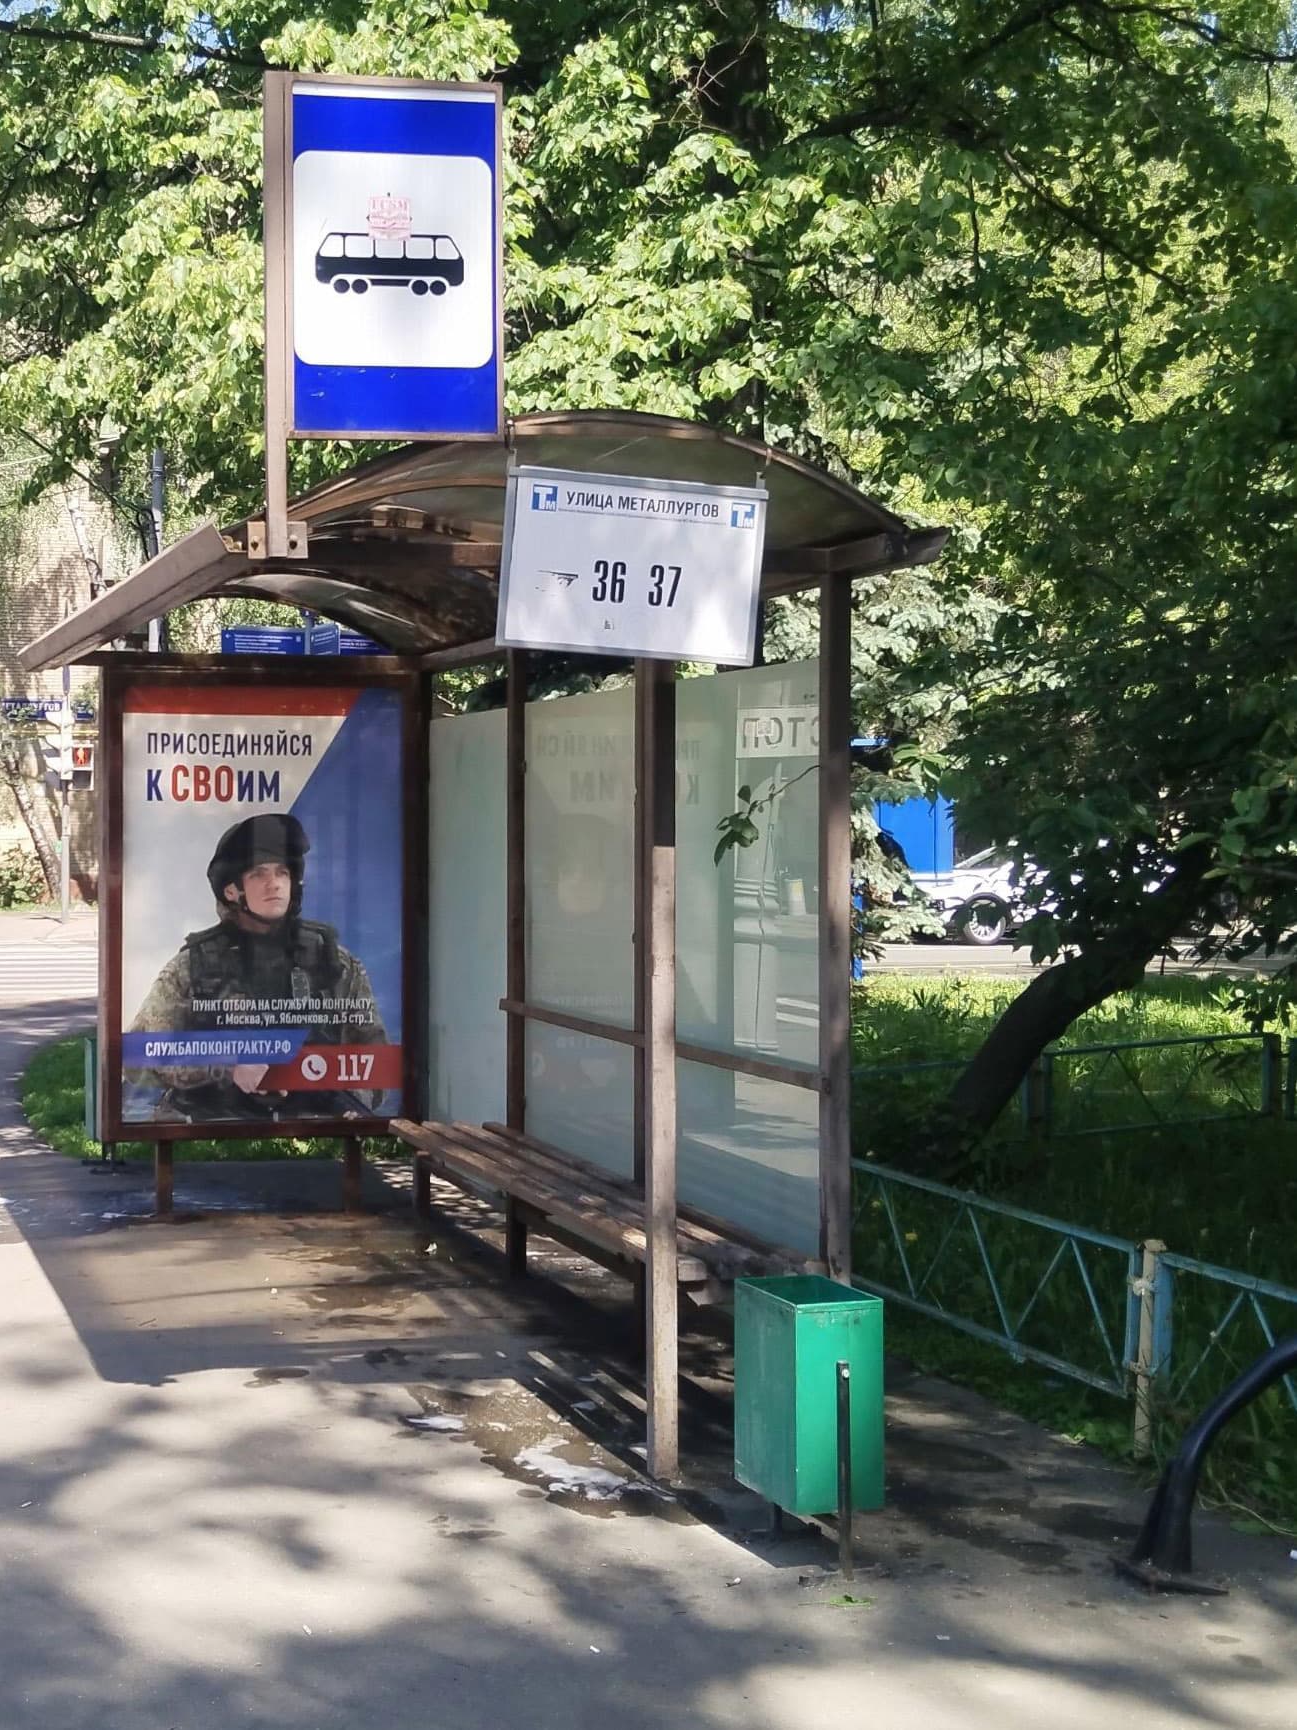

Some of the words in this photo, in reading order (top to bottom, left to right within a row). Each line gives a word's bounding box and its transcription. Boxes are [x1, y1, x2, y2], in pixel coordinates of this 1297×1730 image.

[567, 491, 613, 510] УЛИЦА
[618, 495, 719, 518] МЕТАЛЛУРГОВ
[592, 560, 627, 604] 36
[648, 564, 682, 608] 37
[147, 730, 313, 758] ПРИСОЕДИНЯЙСЯ
[147, 769, 163, 801] К
[171, 764, 280, 802] СВОИМ
[192, 1000, 221, 1012] ПУНКТ
[222, 999, 257, 1011] ОТБОРА
[258, 999, 270, 1011] НА
[271, 999, 307, 1011] СЛУЖБУ
[308, 998, 321, 1010] ПО
[145, 1039, 292, 1057] СЛУЖБАПОКОНТРАКТУ.РФ
[337, 1054, 375, 1081] 117
